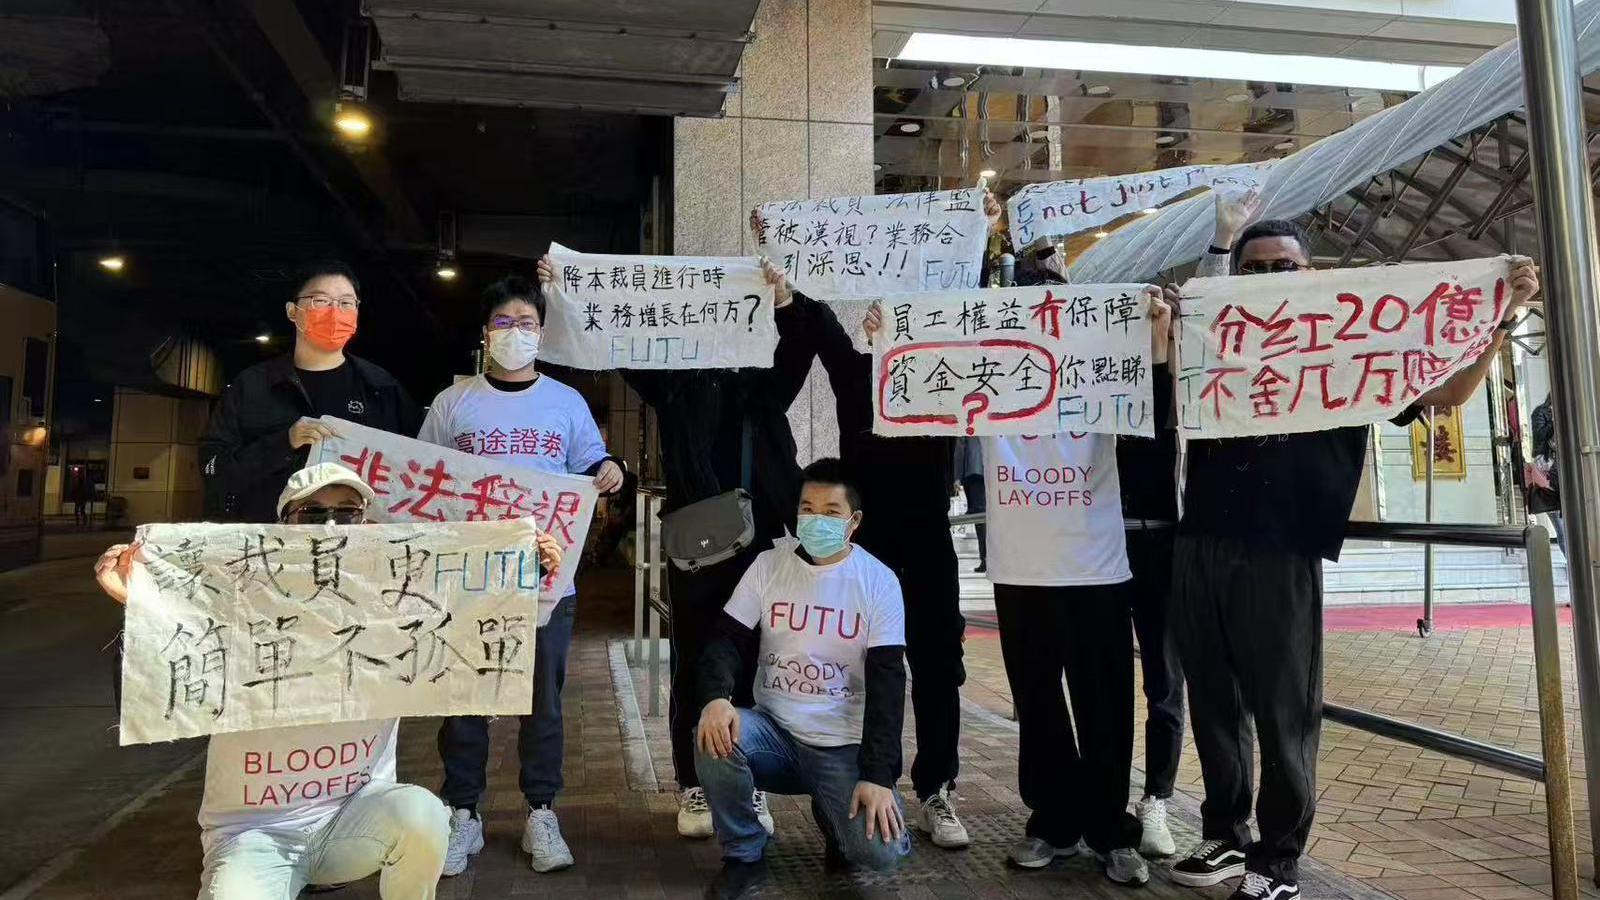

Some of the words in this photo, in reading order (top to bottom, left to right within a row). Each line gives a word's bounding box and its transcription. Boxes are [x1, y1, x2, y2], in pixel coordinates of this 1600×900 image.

[1042, 190, 1103, 220] not
[1111, 175, 1172, 207] just
[563, 264, 725, 293] 降本裁員進行時
[925, 260, 979, 289] FUTU
[583, 294, 761, 332] 業務增長在何方?
[893, 290, 1141, 341] 員工權益冇保障
[611, 336, 699, 363] FUTU
[1058, 394, 1146, 429] FUTU
[997, 466, 1092, 485] BLOODY
[998, 489, 1093, 506] LAYOFFS
[435, 550, 539, 592] FUTU
[770, 602, 860, 639] FUTU
[162, 612, 526, 719] 簡單不孤單
[245, 734, 377, 774] BLOODY
[244, 766, 372, 806] LAYOFFS
